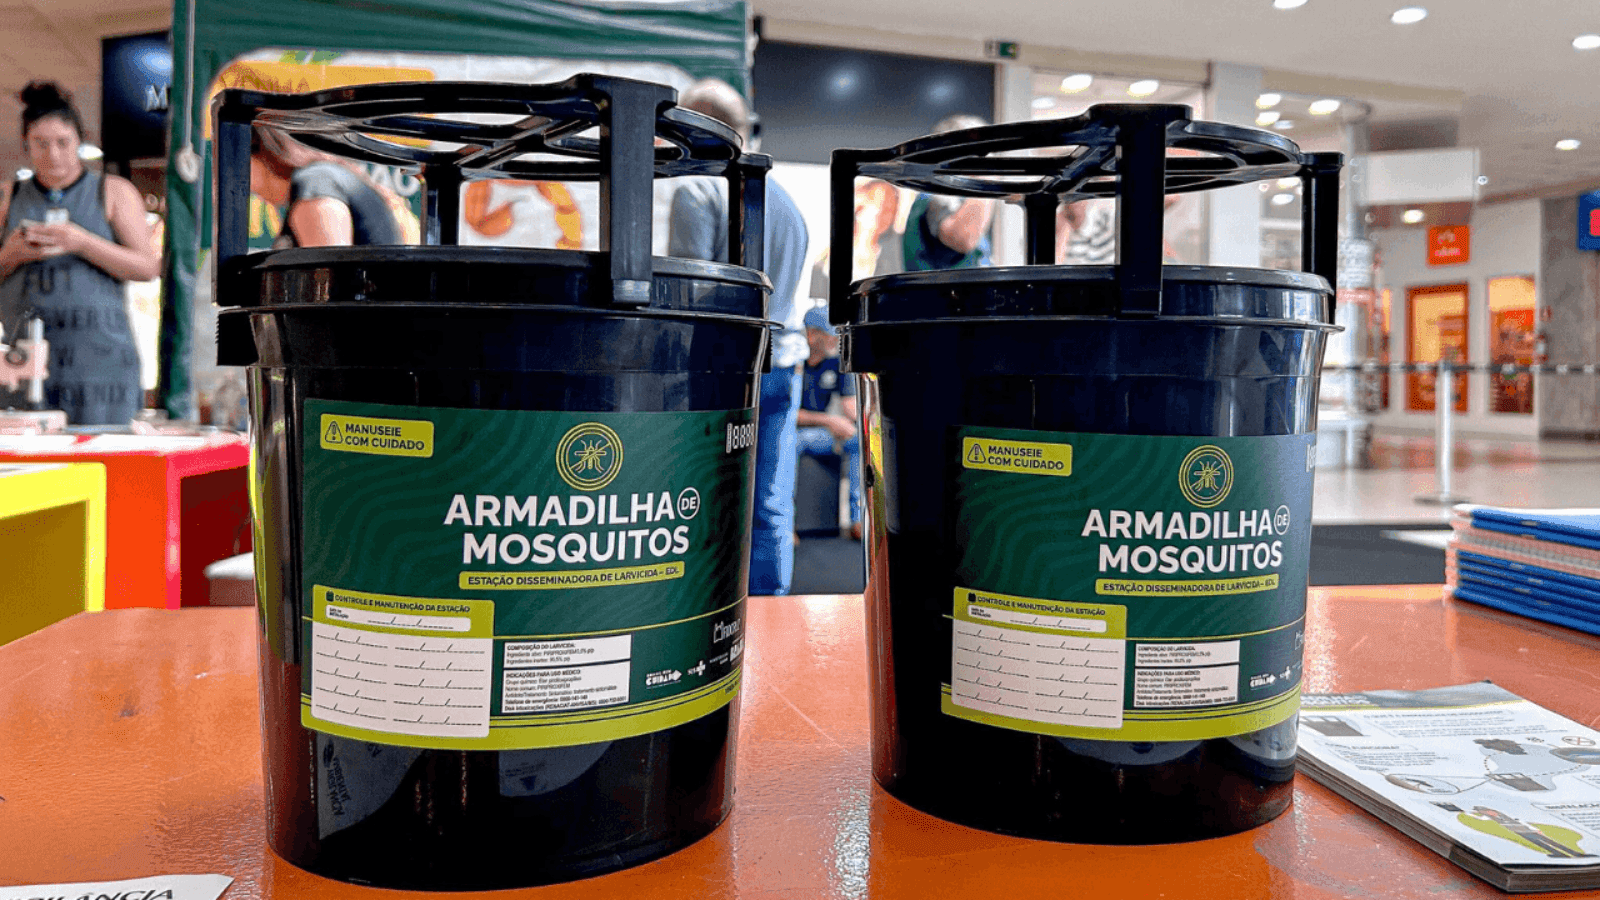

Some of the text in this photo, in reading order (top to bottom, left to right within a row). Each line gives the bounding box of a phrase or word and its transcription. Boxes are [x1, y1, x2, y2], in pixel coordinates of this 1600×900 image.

[345, 423, 402, 438] MANUSEIE
[345, 436, 425, 451] COM CUIDADO
[988, 445, 1043, 458] MANUSEIE
[988, 456, 1065, 471] COM CUIDADO
[443, 492, 697, 525] ARMADILHA DE
[1081, 509, 1288, 540] ARMADILHA DE
[463, 525, 690, 565] MOSQUITOS
[1098, 540, 1283, 574] MOSQUITOS
[467, 575, 517, 588] ESTAÇÃO
[517, 573, 601, 585] DISSEMINADORA
[602, 572, 613, 581] DE
[614, 569, 659, 581] LARVICIDA
[665, 566, 680, 576] EDL
[1103, 581, 1143, 594] ESTAÇÃO
[1144, 581, 1215, 593] DISSEMINADORA
[1216, 582, 1226, 591] DE
[1226, 580, 1260, 591] LARVICIDA
[335, 594, 368, 606] CONTROLE
[374, 600, 425, 611] MANUTENÇÃO
[437, 605, 471, 613] ESTAÇÃO
[978, 596, 1010, 607] CONTROLE
[1017, 602, 1064, 613] MANUTENÇÃO
[1075, 607, 1106, 616] ESTAÇÃO
